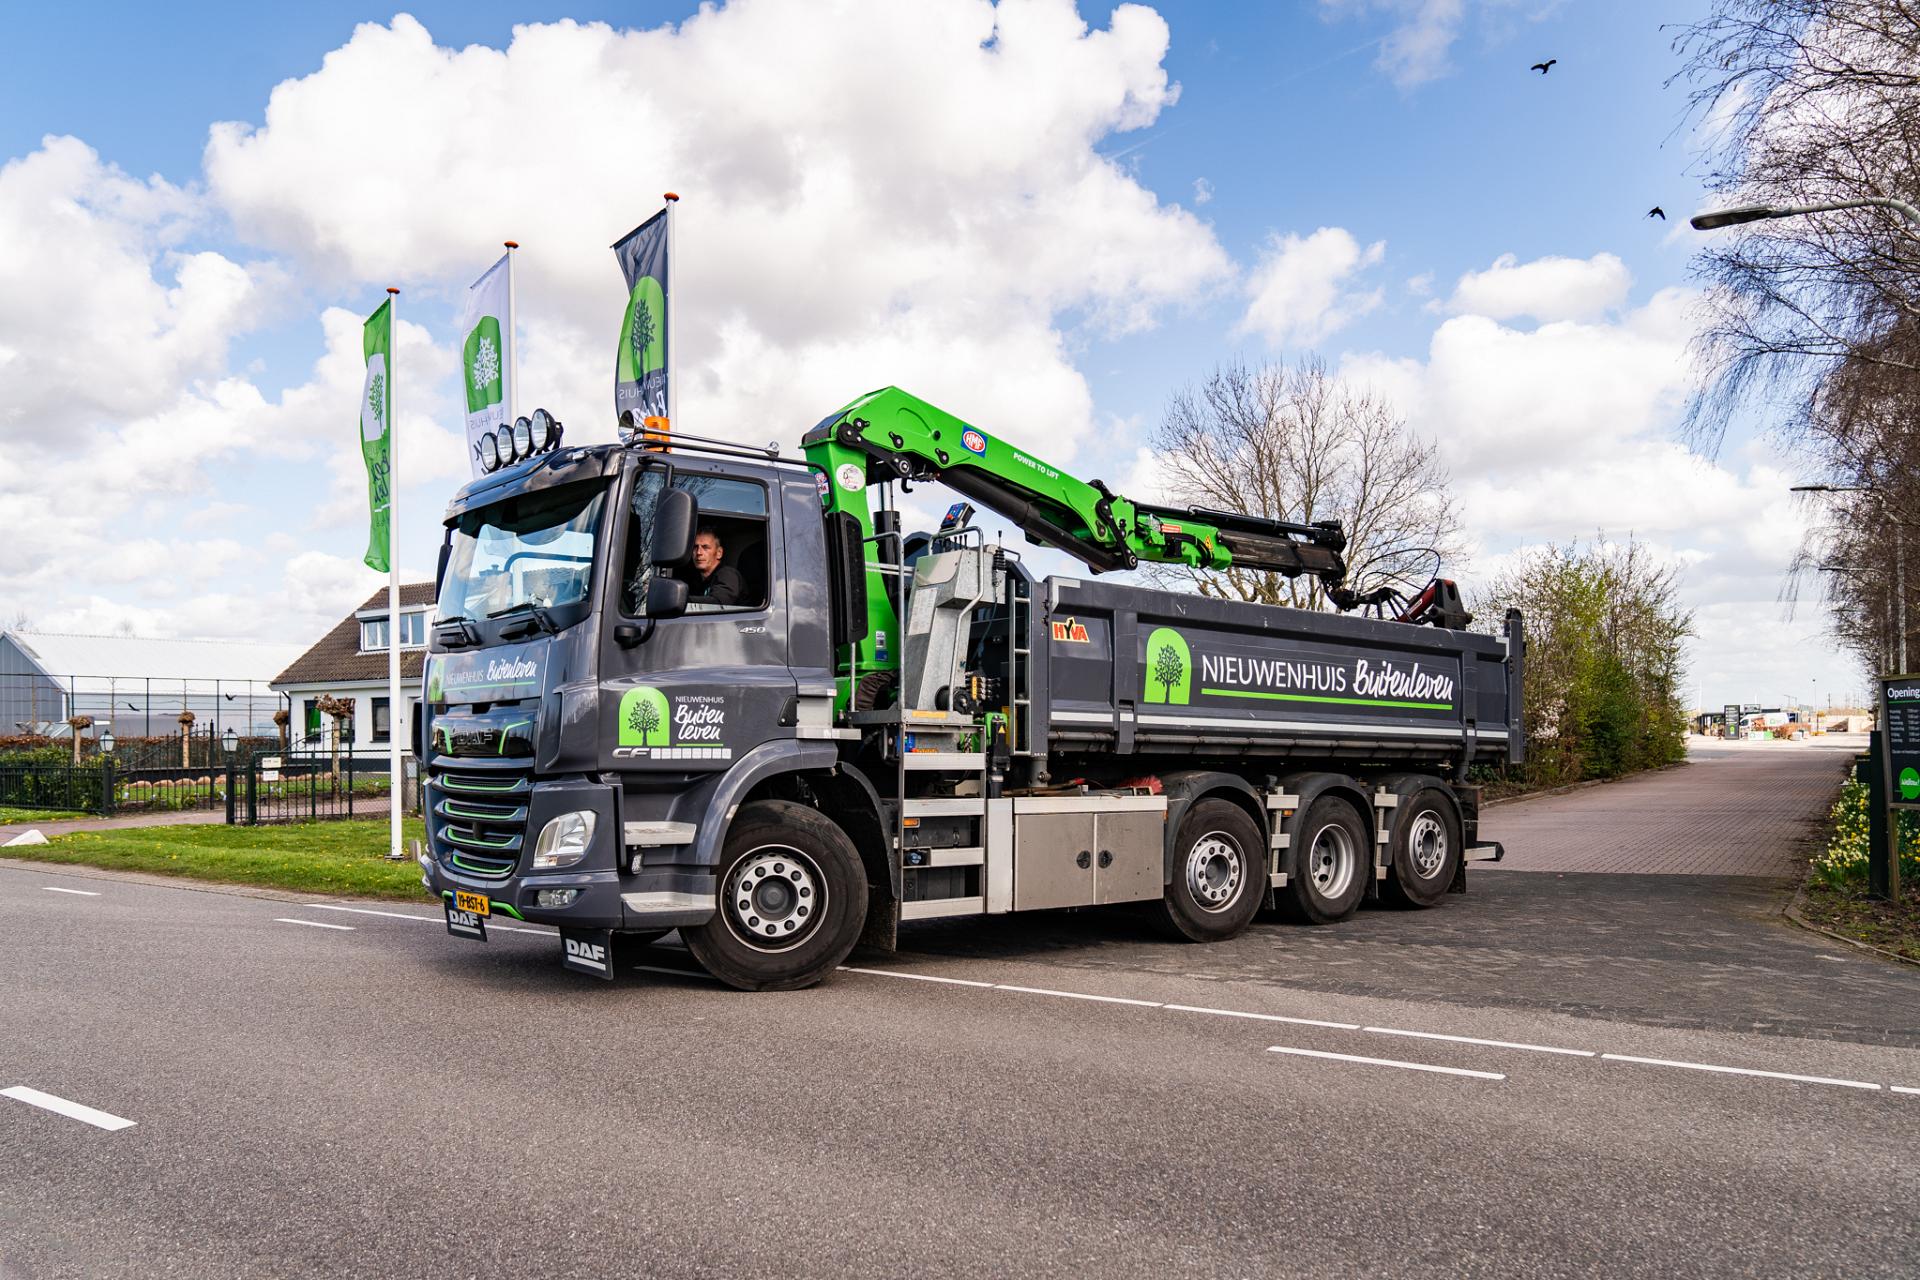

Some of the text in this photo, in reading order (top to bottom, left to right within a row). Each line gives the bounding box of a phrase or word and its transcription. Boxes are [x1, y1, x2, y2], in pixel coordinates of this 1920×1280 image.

[965, 433, 983, 450] HMF
[1013, 452, 1060, 480] POWER TO LIFT
[739, 626, 766, 634] 450
[1053, 619, 1088, 641] HYVA
[446, 656, 538, 686] NIEUWENHUIS Buitenleven
[1202, 654, 1453, 701] NIEUWENHUIS Buitenleven
[675, 695, 725, 704] NIEUWENHUIS
[674, 704, 725, 724] Buiten
[678, 723, 720, 740] leven
[612, 748, 650, 758] CF
[449, 910, 479, 927] DAF
[565, 938, 604, 960] DAF
